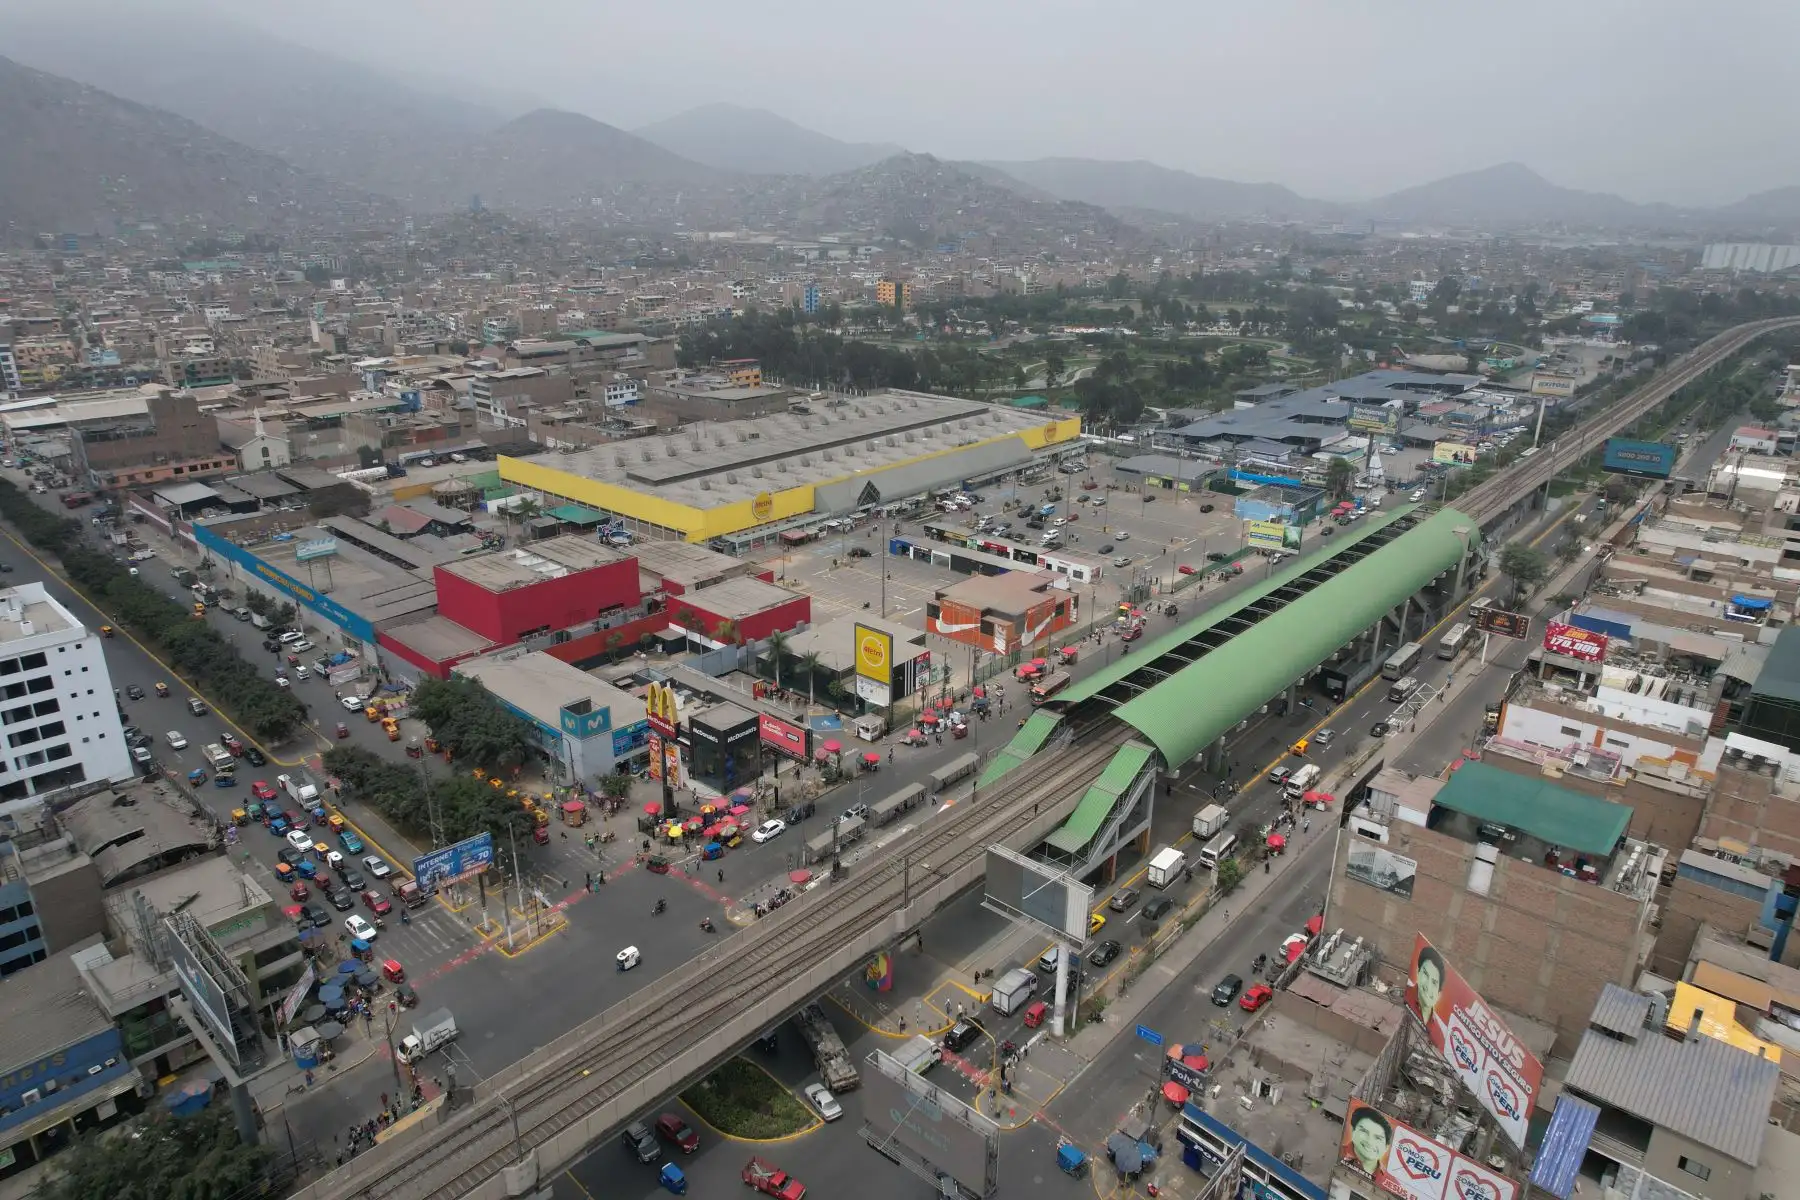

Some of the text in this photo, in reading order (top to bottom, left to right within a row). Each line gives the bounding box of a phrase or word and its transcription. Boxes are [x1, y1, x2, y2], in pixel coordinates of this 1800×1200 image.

[863, 646, 883, 657] Metro
[647, 714, 675, 733] McDonald's
[692, 727, 718, 743] McDonald's
[727, 726, 757, 743] McDonald's
[1493, 1090, 1521, 1122] PERU
[1397, 1143, 1425, 1162] SOMOS
[1406, 1156, 1443, 1180] PERU
[1455, 1174, 1487, 1195] SOMOS
